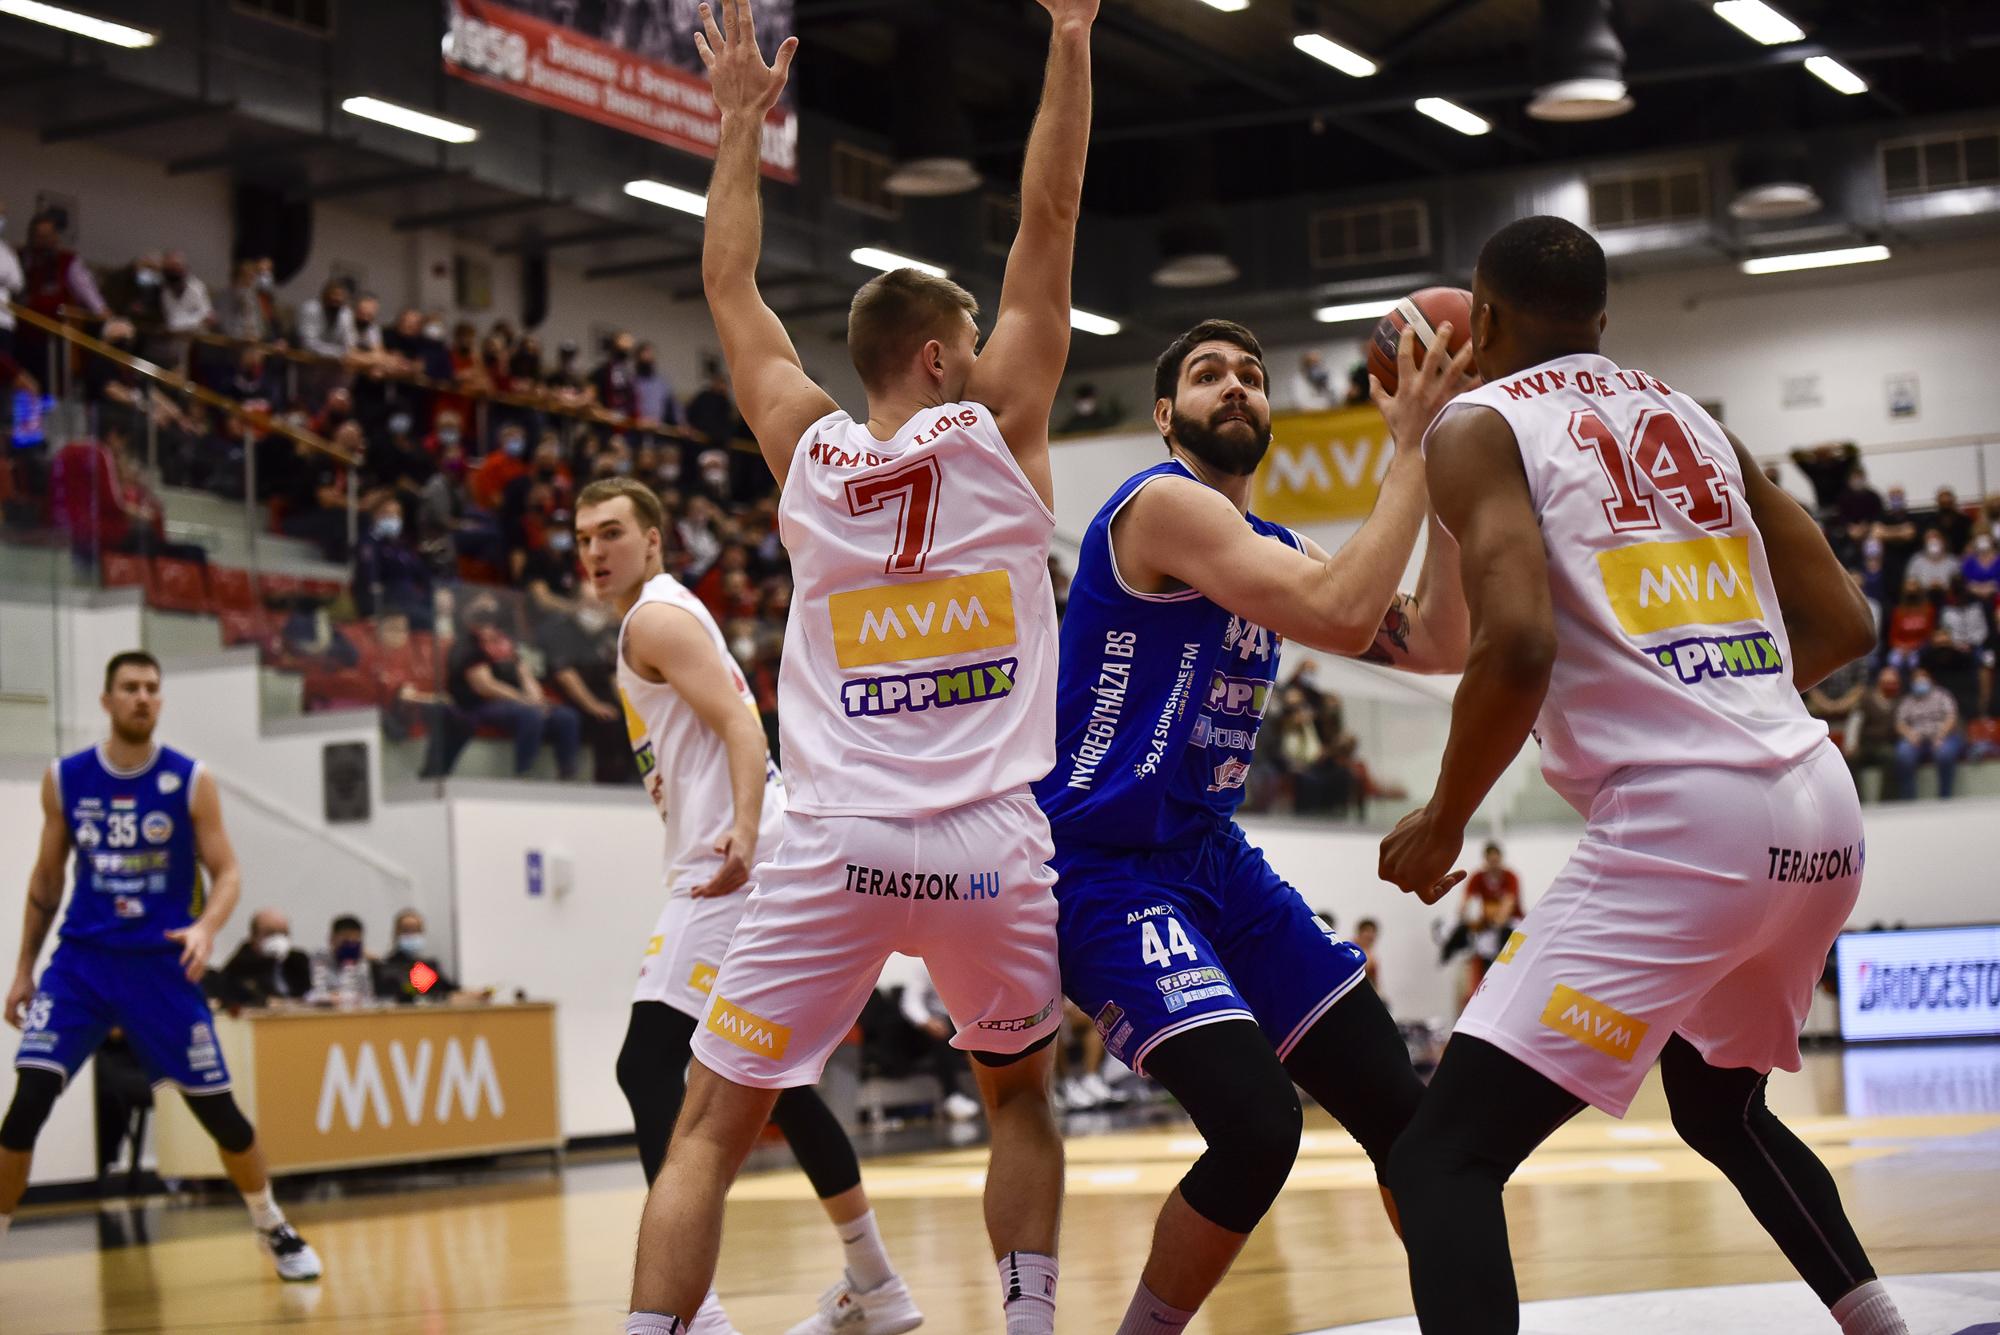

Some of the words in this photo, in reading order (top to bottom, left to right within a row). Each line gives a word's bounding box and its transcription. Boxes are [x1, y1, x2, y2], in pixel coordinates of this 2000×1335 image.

[1567, 408, 1733, 534] 14
[843, 454, 942, 575] 7
[1639, 560, 1747, 608] MVM
[859, 596, 990, 645] MVM
[1067, 662, 1132, 791] NYÍREGYHÁZA
[1104, 630, 1137, 659] BS
[1142, 739, 1168, 774] 99.4
[1155, 671, 1190, 738] SUNSHINE
[1180, 643, 1201, 669] FM
[1209, 726, 1259, 750] HÜBN
[107, 811, 139, 848] 35
[846, 863, 1000, 900] TERASZOK.HU
[1768, 838, 1865, 884] TERASZOK.H
[1127, 904, 1175, 926] ALANEX
[1142, 916, 1198, 968] 44
[1857, 959, 2000, 1012] BRIDGESTO
[717, 1011, 774, 1049] MVM
[1560, 1004, 1632, 1049] MVM
[315, 1034, 507, 1135] MVM
